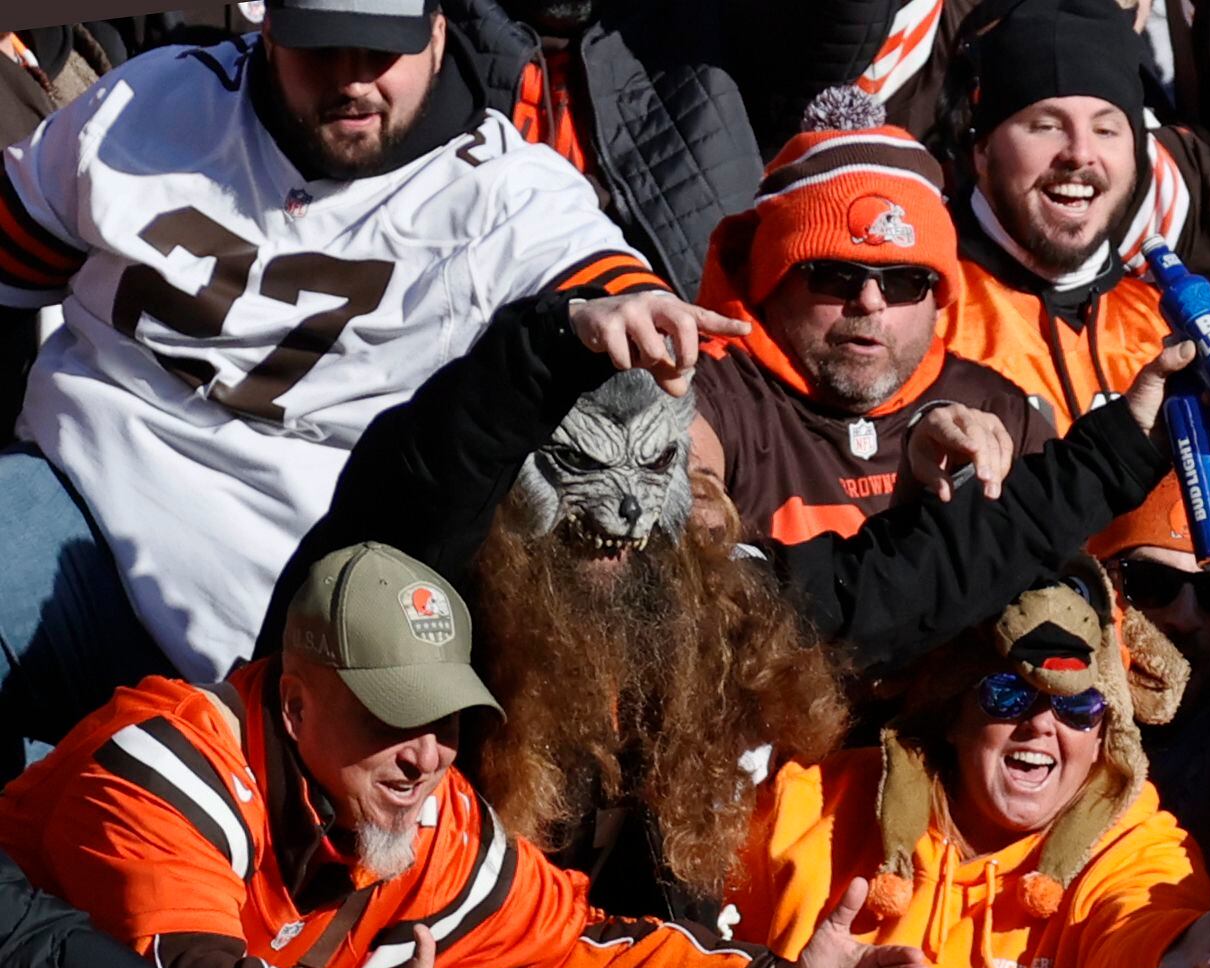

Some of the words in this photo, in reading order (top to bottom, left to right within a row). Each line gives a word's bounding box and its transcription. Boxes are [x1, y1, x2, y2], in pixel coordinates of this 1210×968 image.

[111, 205, 396, 425] 27
[1177, 436, 1199, 490] LIGHT
[1190, 489, 1207, 522] BUD
